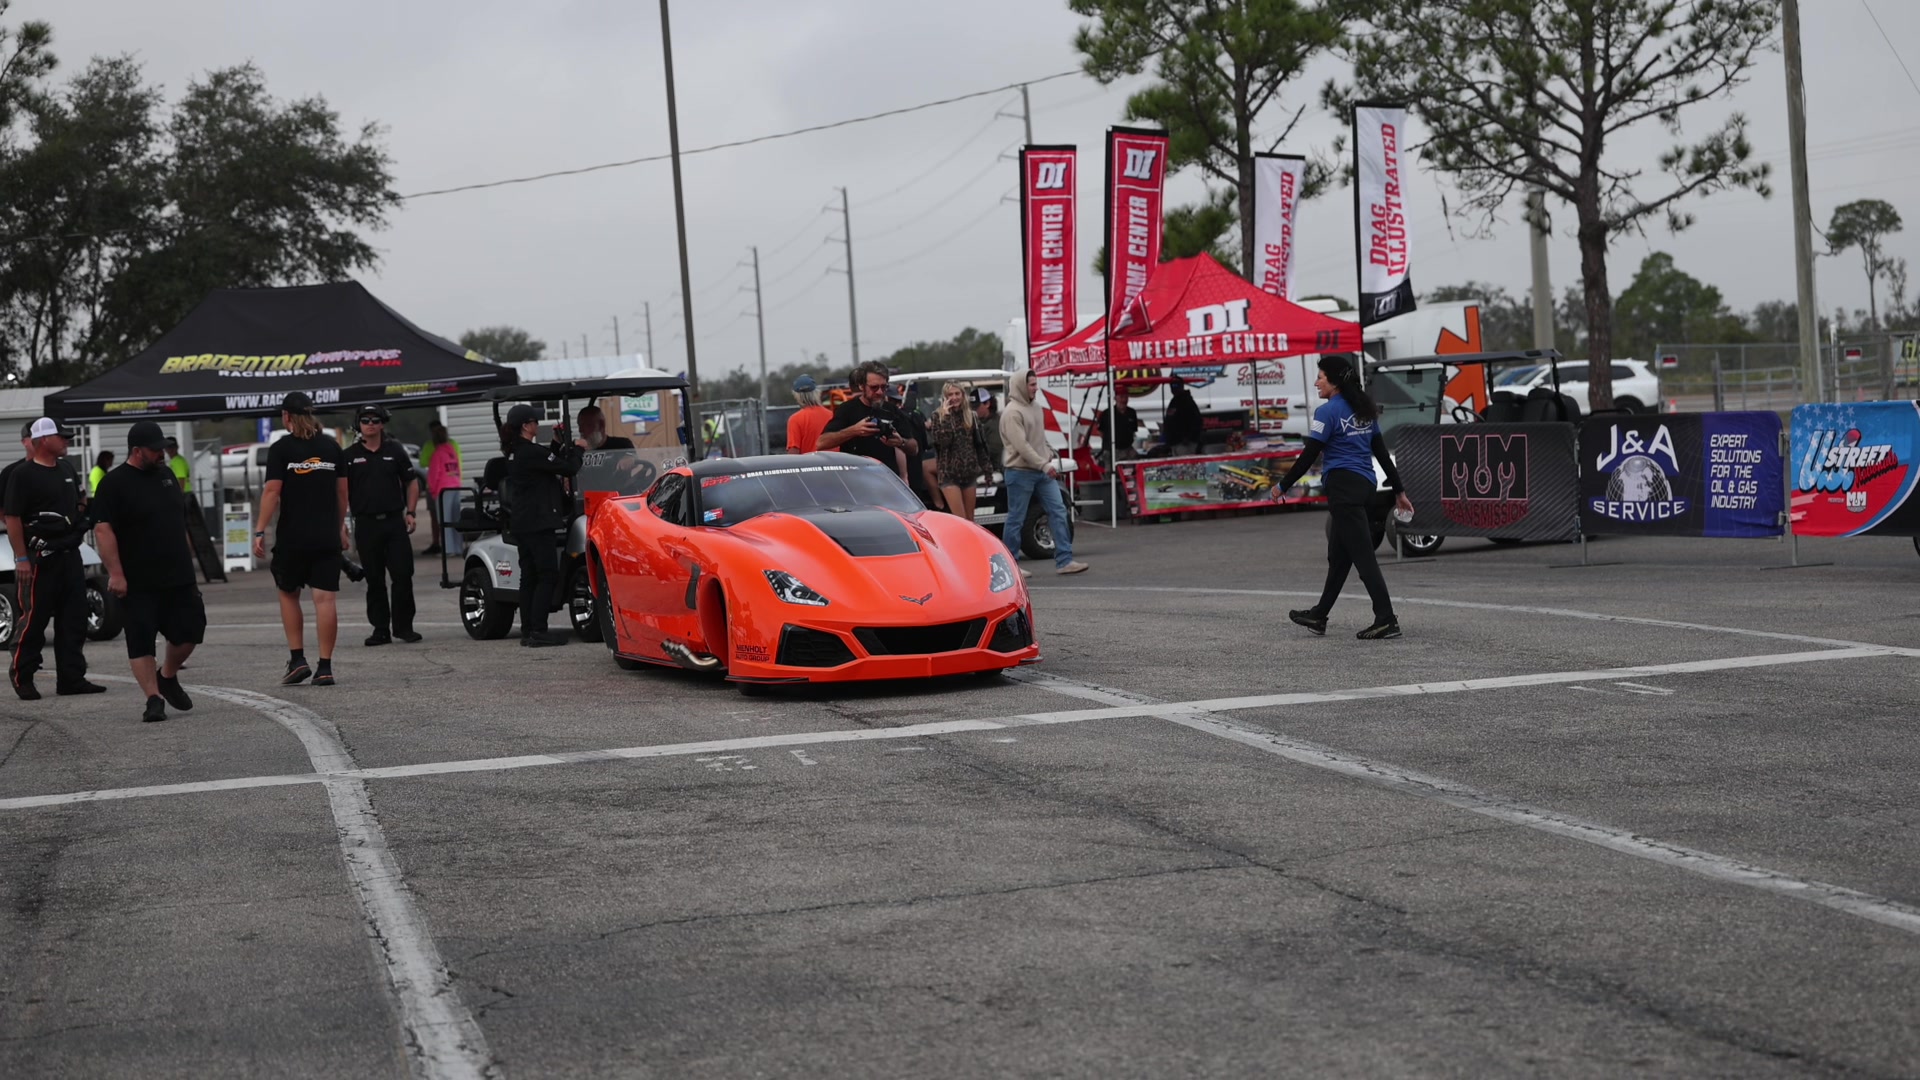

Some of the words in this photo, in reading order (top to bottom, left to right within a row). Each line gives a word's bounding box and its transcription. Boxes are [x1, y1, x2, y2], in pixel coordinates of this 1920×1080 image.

[1036, 162, 1066, 189] DI
[1124, 148, 1155, 180] DI
[1381, 123, 1407, 277] ILLUSTRATED
[1042, 204, 1064, 259] CENTER
[1129, 196, 1148, 257] CENTER
[1370, 203, 1389, 267] DRAG
[1041, 263, 1064, 335] WELCOME
[1186, 299, 1252, 337] DI
[1128, 335, 1213, 361] WELCOME
[1222, 333, 1288, 355] CENTER
[1314, 329, 1340, 350] DI
[159, 354, 307, 374] BRADENTON
[218, 366, 345, 378] RACEBMP.com
[1596, 424, 1680, 472] J&A
[1710, 434, 1748, 448] EXPERT
[1710, 450, 1762, 463] SOLUTIONS
[1825, 444, 1891, 468] STREET
[764, 468, 800, 476] ILLUSTRATED
[1710, 465, 1730, 478] FOR
[1734, 465, 1753, 479] THE
[1711, 480, 1724, 493] OIL
[1728, 480, 1735, 493] &
[1738, 481, 1758, 494] GAS
[1441, 500, 1529, 528] TRANSMISSION
[1593, 500, 1686, 520] SERVICE
[1711, 495, 1757, 509] INDUSTRY
